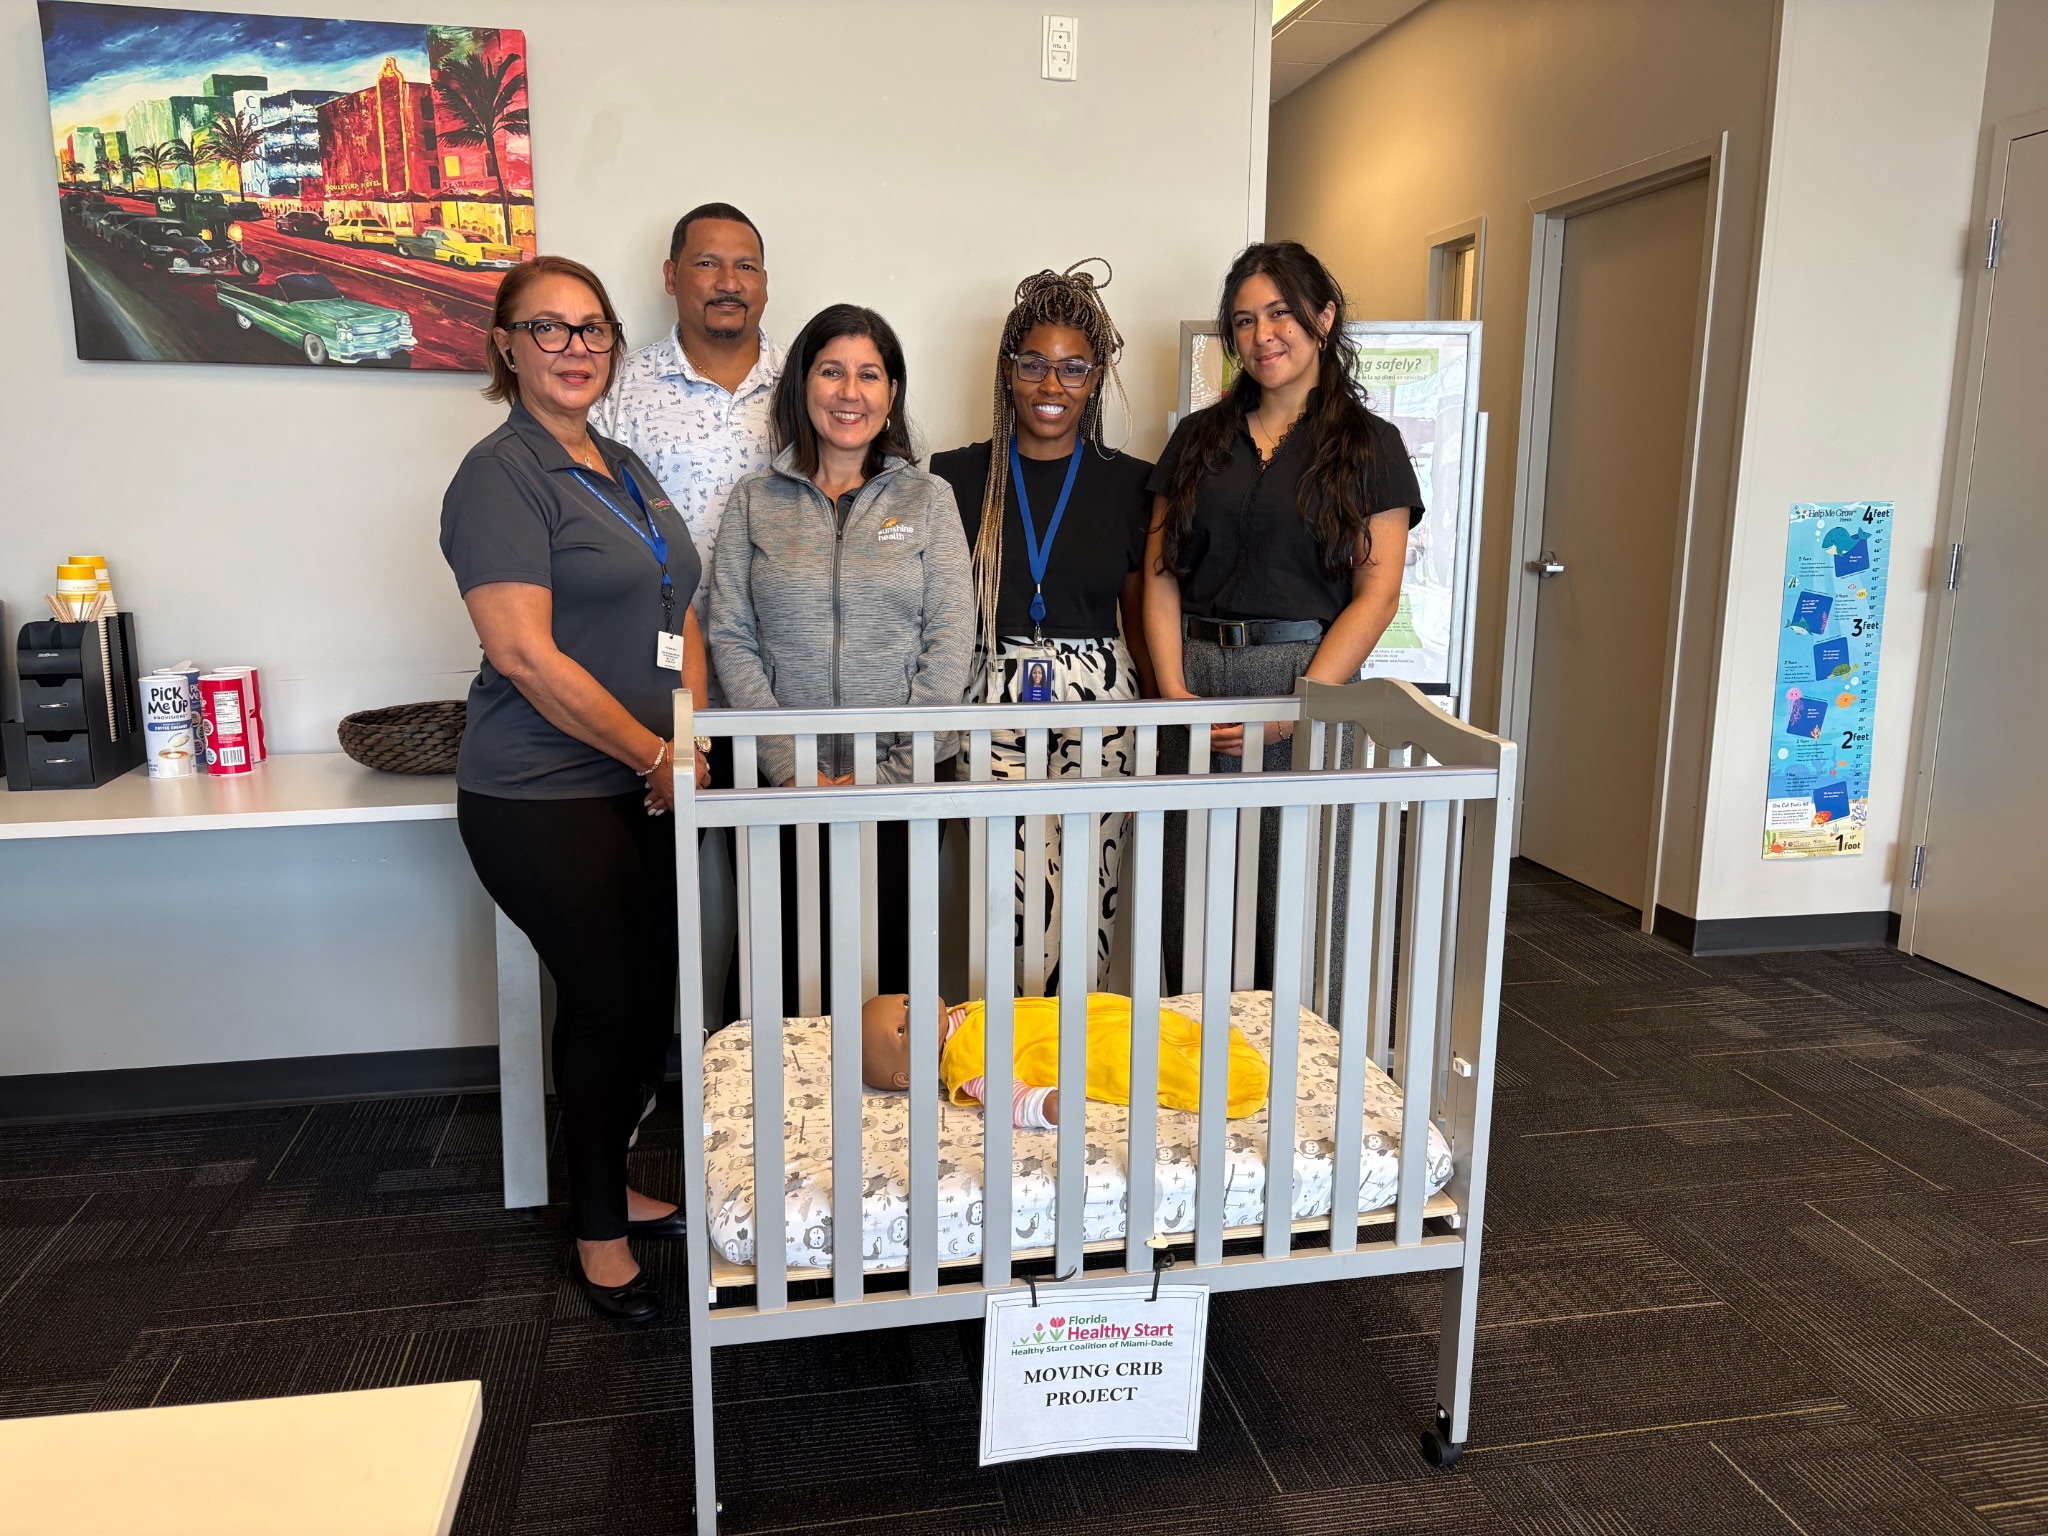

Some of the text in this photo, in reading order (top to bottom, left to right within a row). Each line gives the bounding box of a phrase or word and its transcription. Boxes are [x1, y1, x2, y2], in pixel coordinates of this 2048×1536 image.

[1376, 358, 1421, 372] safely?
[1808, 510, 1824, 518] Help
[1836, 508, 1853, 516] Grow
[1863, 506, 1890, 524] 4 feet
[878, 533, 904, 541] health
[1851, 618, 1879, 637] 3 feet
[148, 700, 188, 715] Me UP
[1841, 731, 1869, 749] 2 feet
[1835, 834, 1844, 851] 1
[1844, 842, 1861, 850] foot
[1069, 1315, 1107, 1325] Florida
[1068, 1323, 1174, 1340] Healthy Start
[1011, 1347, 1045, 1356] Healthy
[1069, 1342, 1107, 1351] Coalition
[1024, 1361, 1163, 1384] MOVING CRIB
[1045, 1387, 1138, 1407] PROJECT
